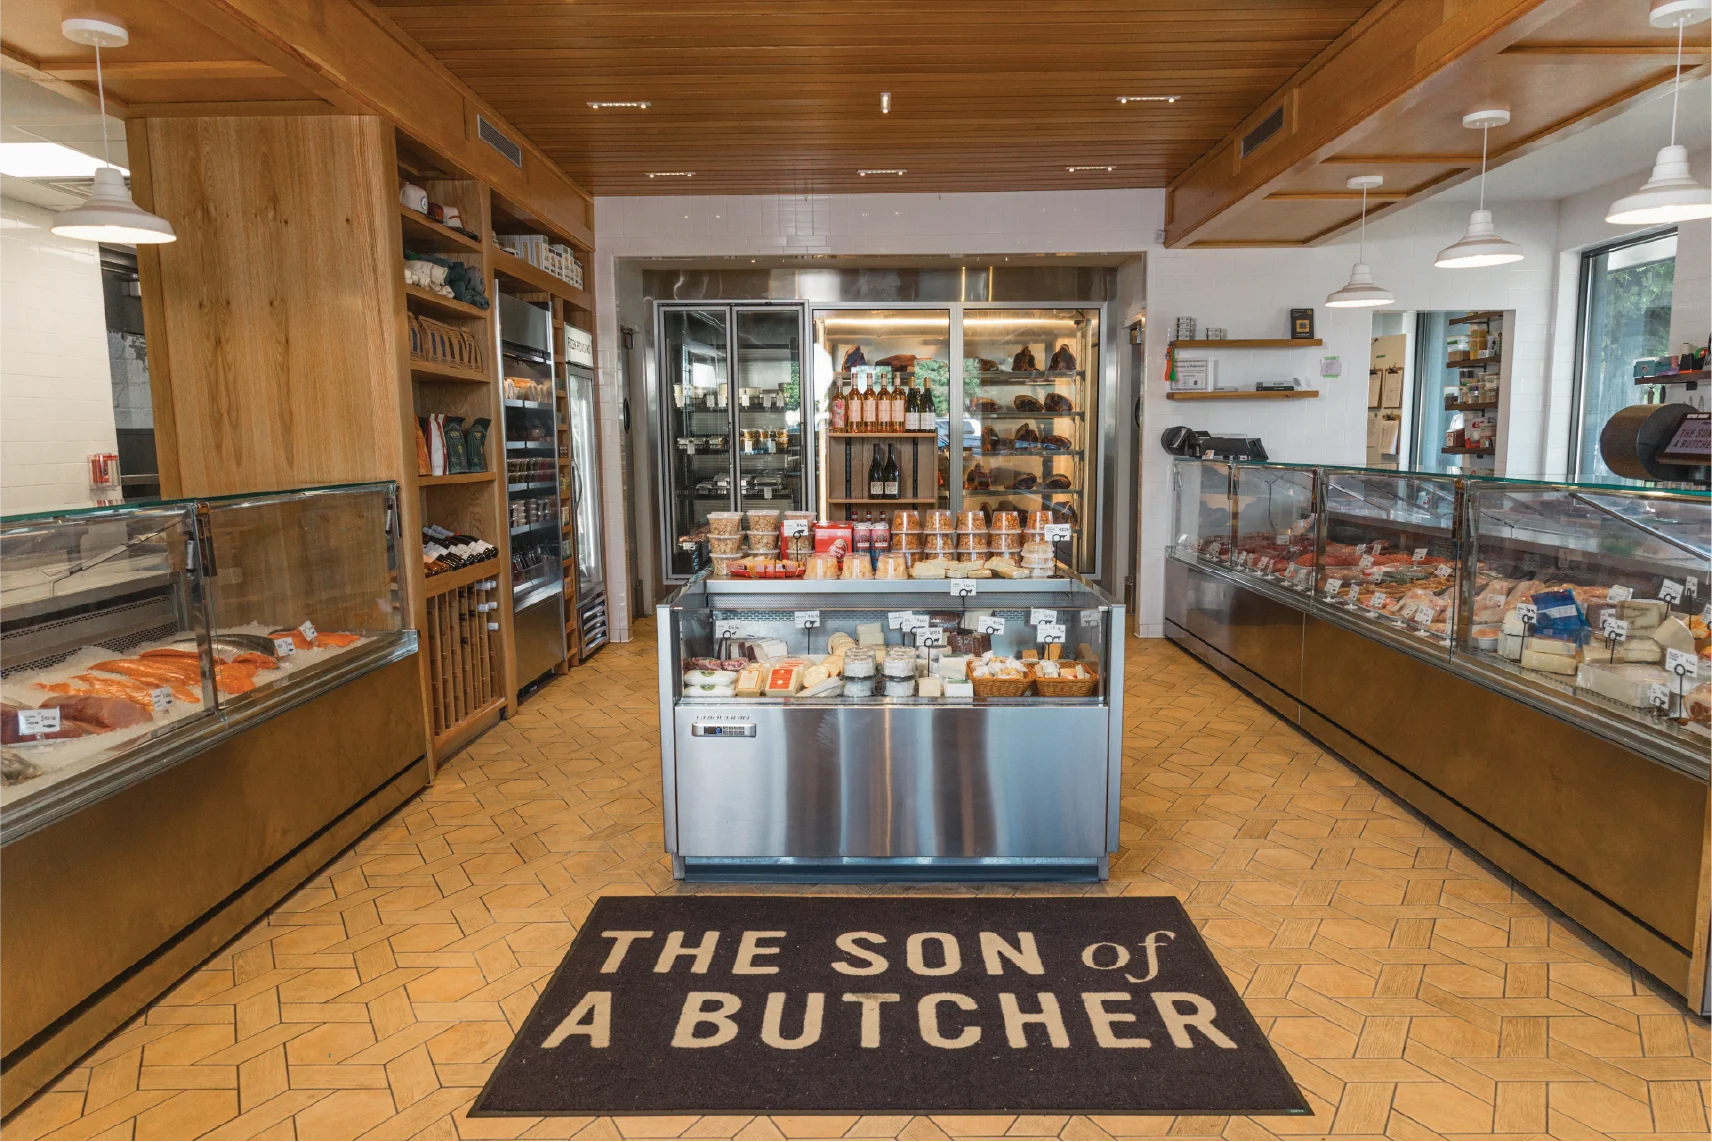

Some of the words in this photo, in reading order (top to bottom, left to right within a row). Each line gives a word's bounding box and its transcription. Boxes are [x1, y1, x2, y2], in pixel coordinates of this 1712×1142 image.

[1679, 428, 1695, 438] THE
[1680, 439, 1712, 449] BUTCHE
[600, 930, 787, 975] THE
[830, 930, 1045, 976] SON
[1081, 931, 1176, 983] of
[541, 990, 612, 1049] A
[671, 991, 1238, 1050] BUTCHER
